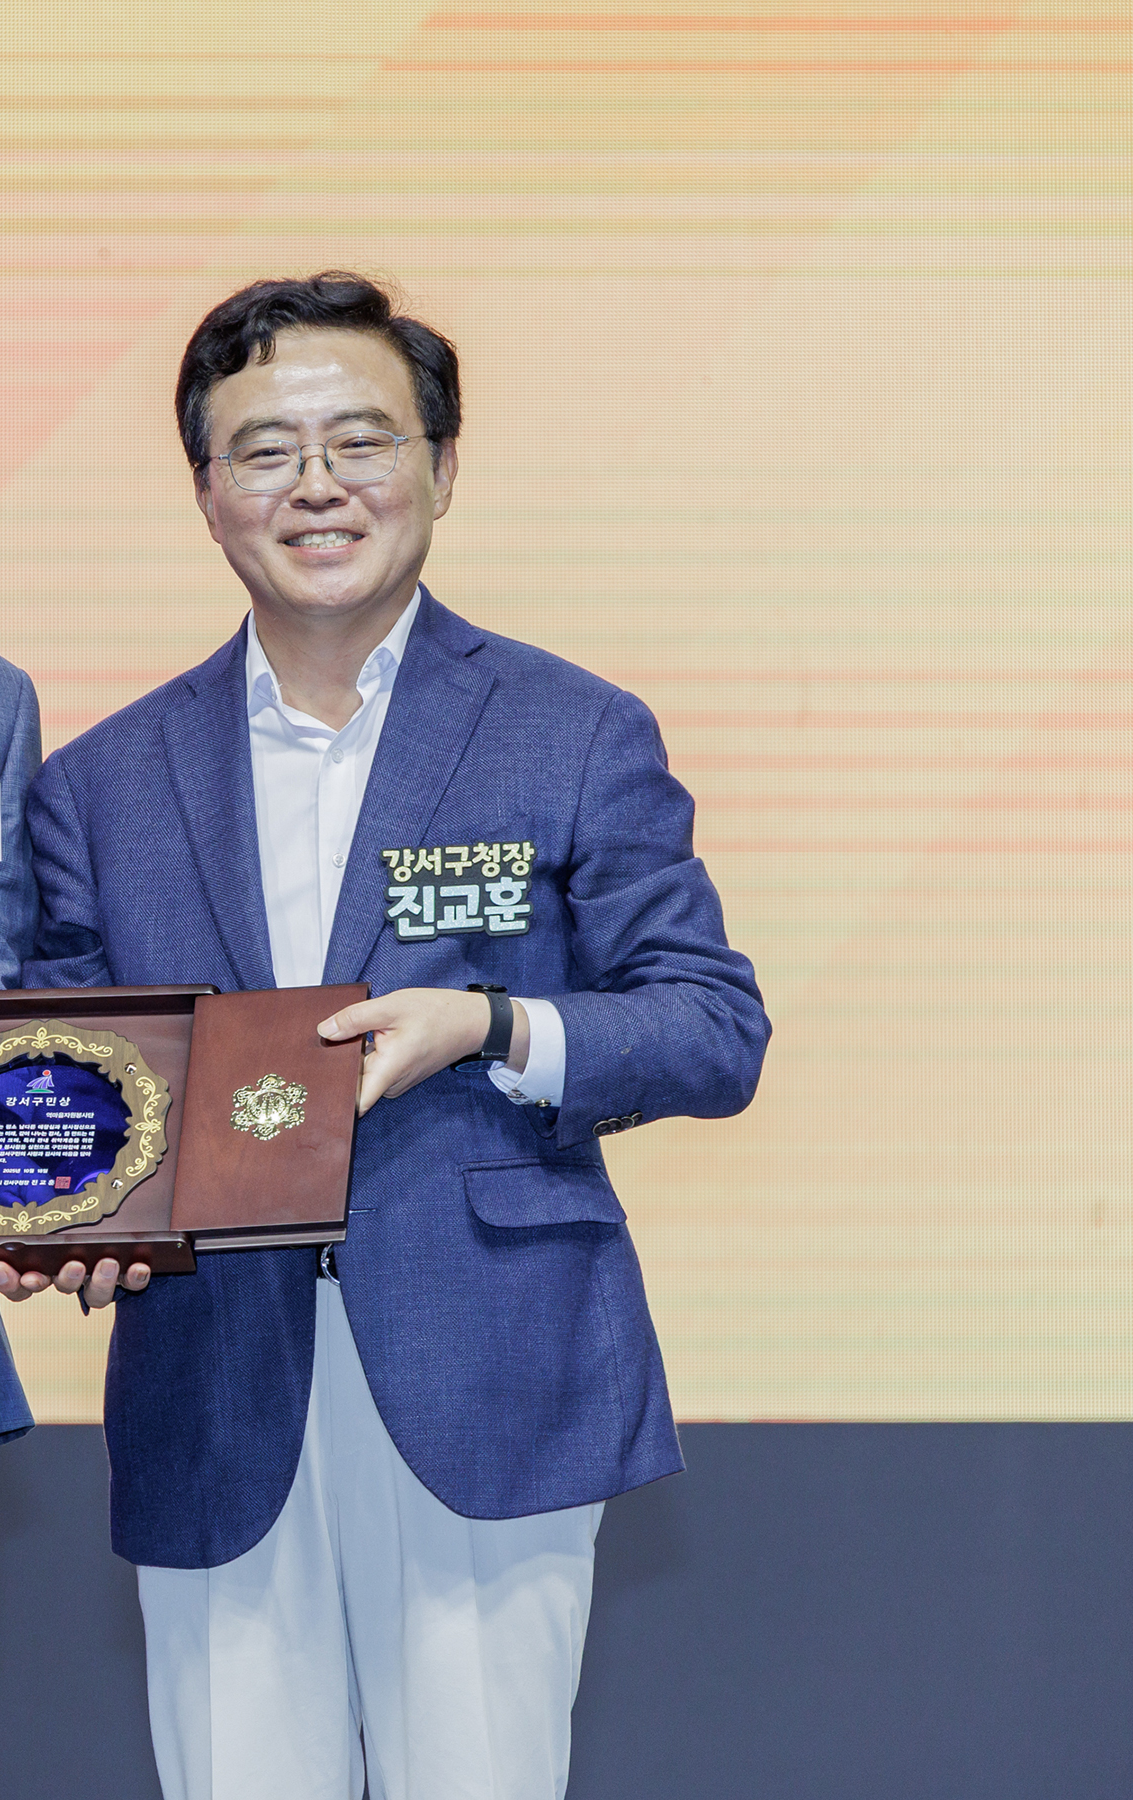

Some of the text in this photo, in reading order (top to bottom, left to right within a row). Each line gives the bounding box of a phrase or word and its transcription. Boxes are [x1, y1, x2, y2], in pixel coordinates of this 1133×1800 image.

[382, 841, 535, 883] 강서구청장
[387, 876, 531, 937] 진교훈
[5, 1096, 71, 1107] 강서구민상
